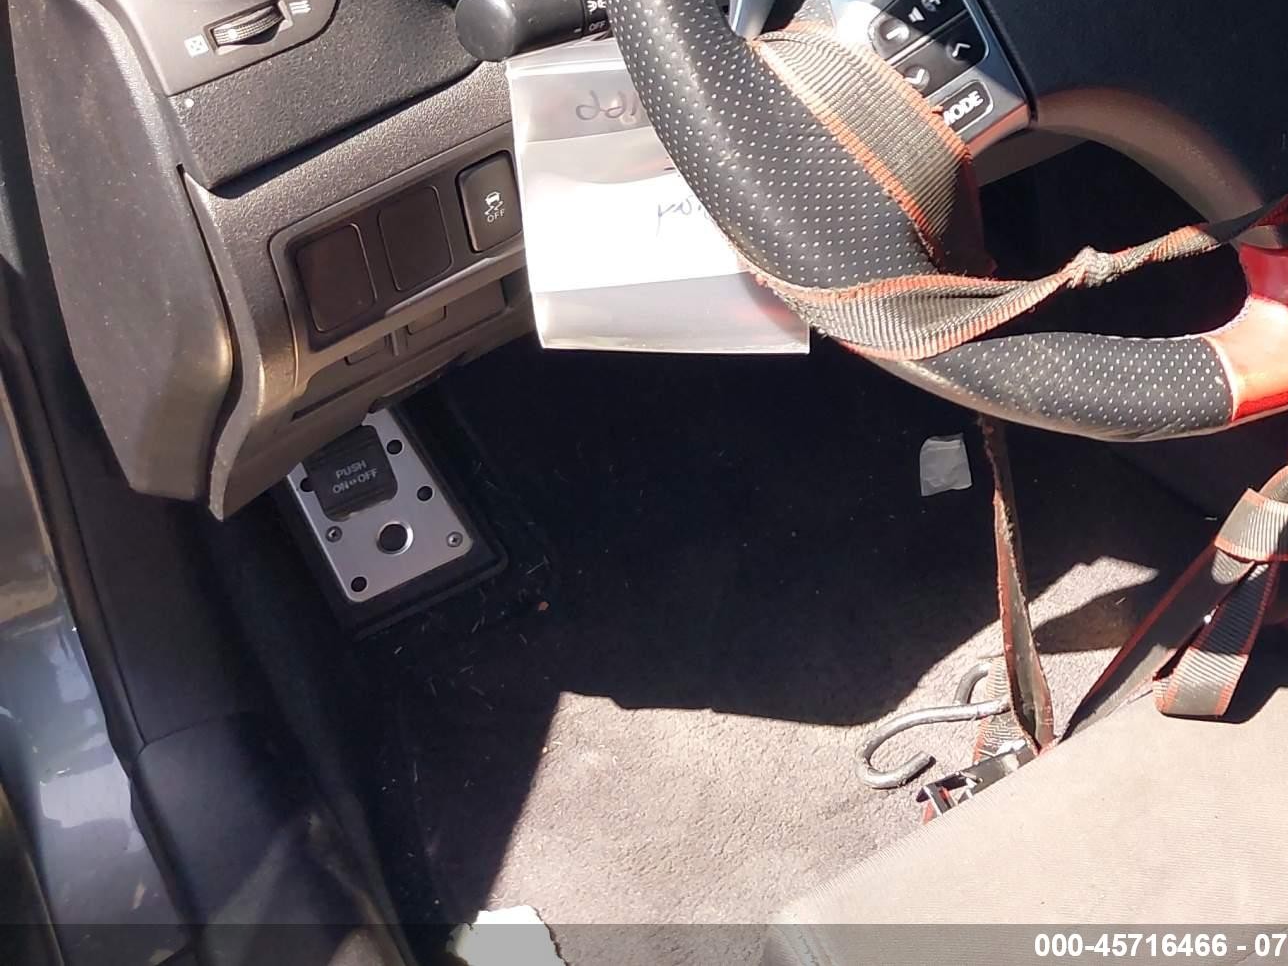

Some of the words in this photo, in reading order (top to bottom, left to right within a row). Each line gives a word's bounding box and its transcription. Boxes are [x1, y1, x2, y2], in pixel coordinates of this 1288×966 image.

[589, 20, 606, 32] OFF
[943, 90, 984, 126] MODE
[486, 208, 505, 223] OFF
[335, 460, 367, 480] PUSH
